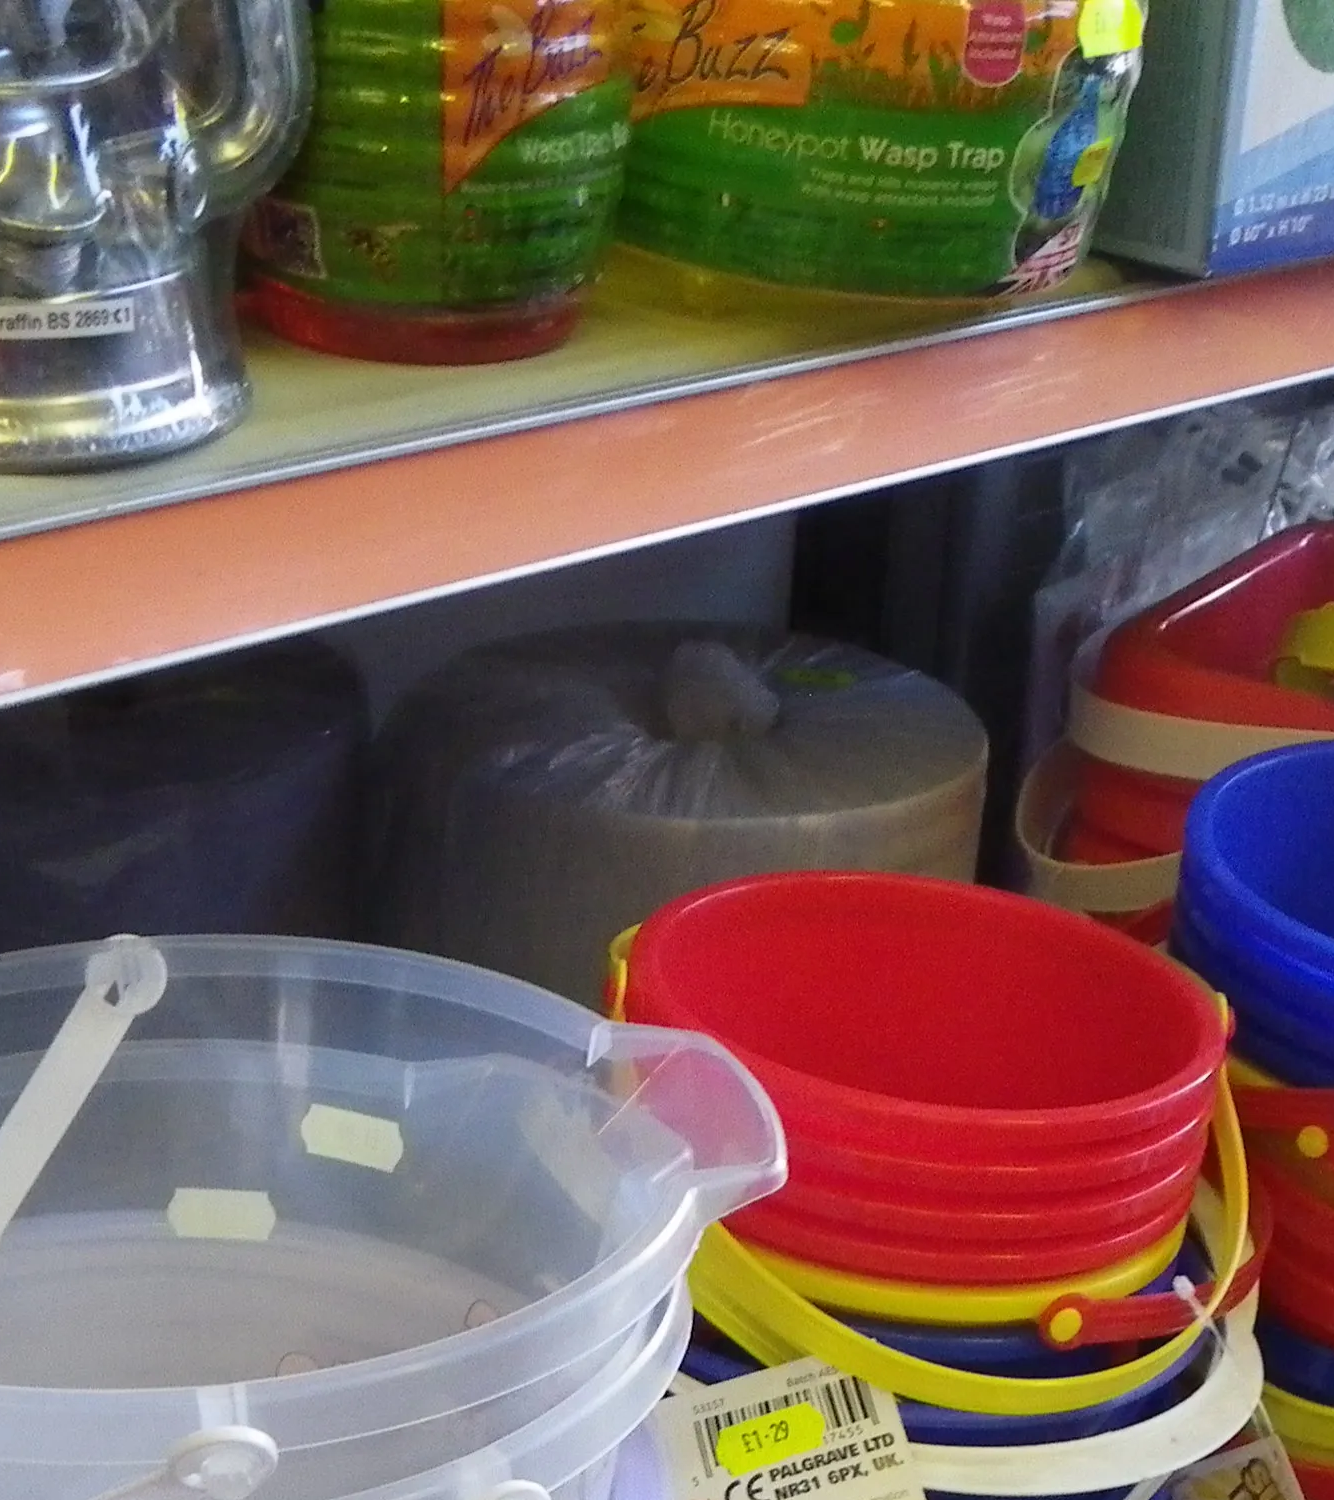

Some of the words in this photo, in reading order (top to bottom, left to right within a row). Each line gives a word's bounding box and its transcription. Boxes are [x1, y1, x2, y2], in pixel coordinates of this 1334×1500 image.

[708, 109, 849, 160] Honeypot
[858, 135, 939, 173] Wasp
[944, 141, 1005, 173] Trap
[769, 1443, 861, 1482] PALGRAVE
[863, 1432, 895, 1453] LTD
[775, 1476, 821, 1500] NR31
[828, 1463, 869, 1485] 6PX,
[872, 1453, 905, 1472] UK.
